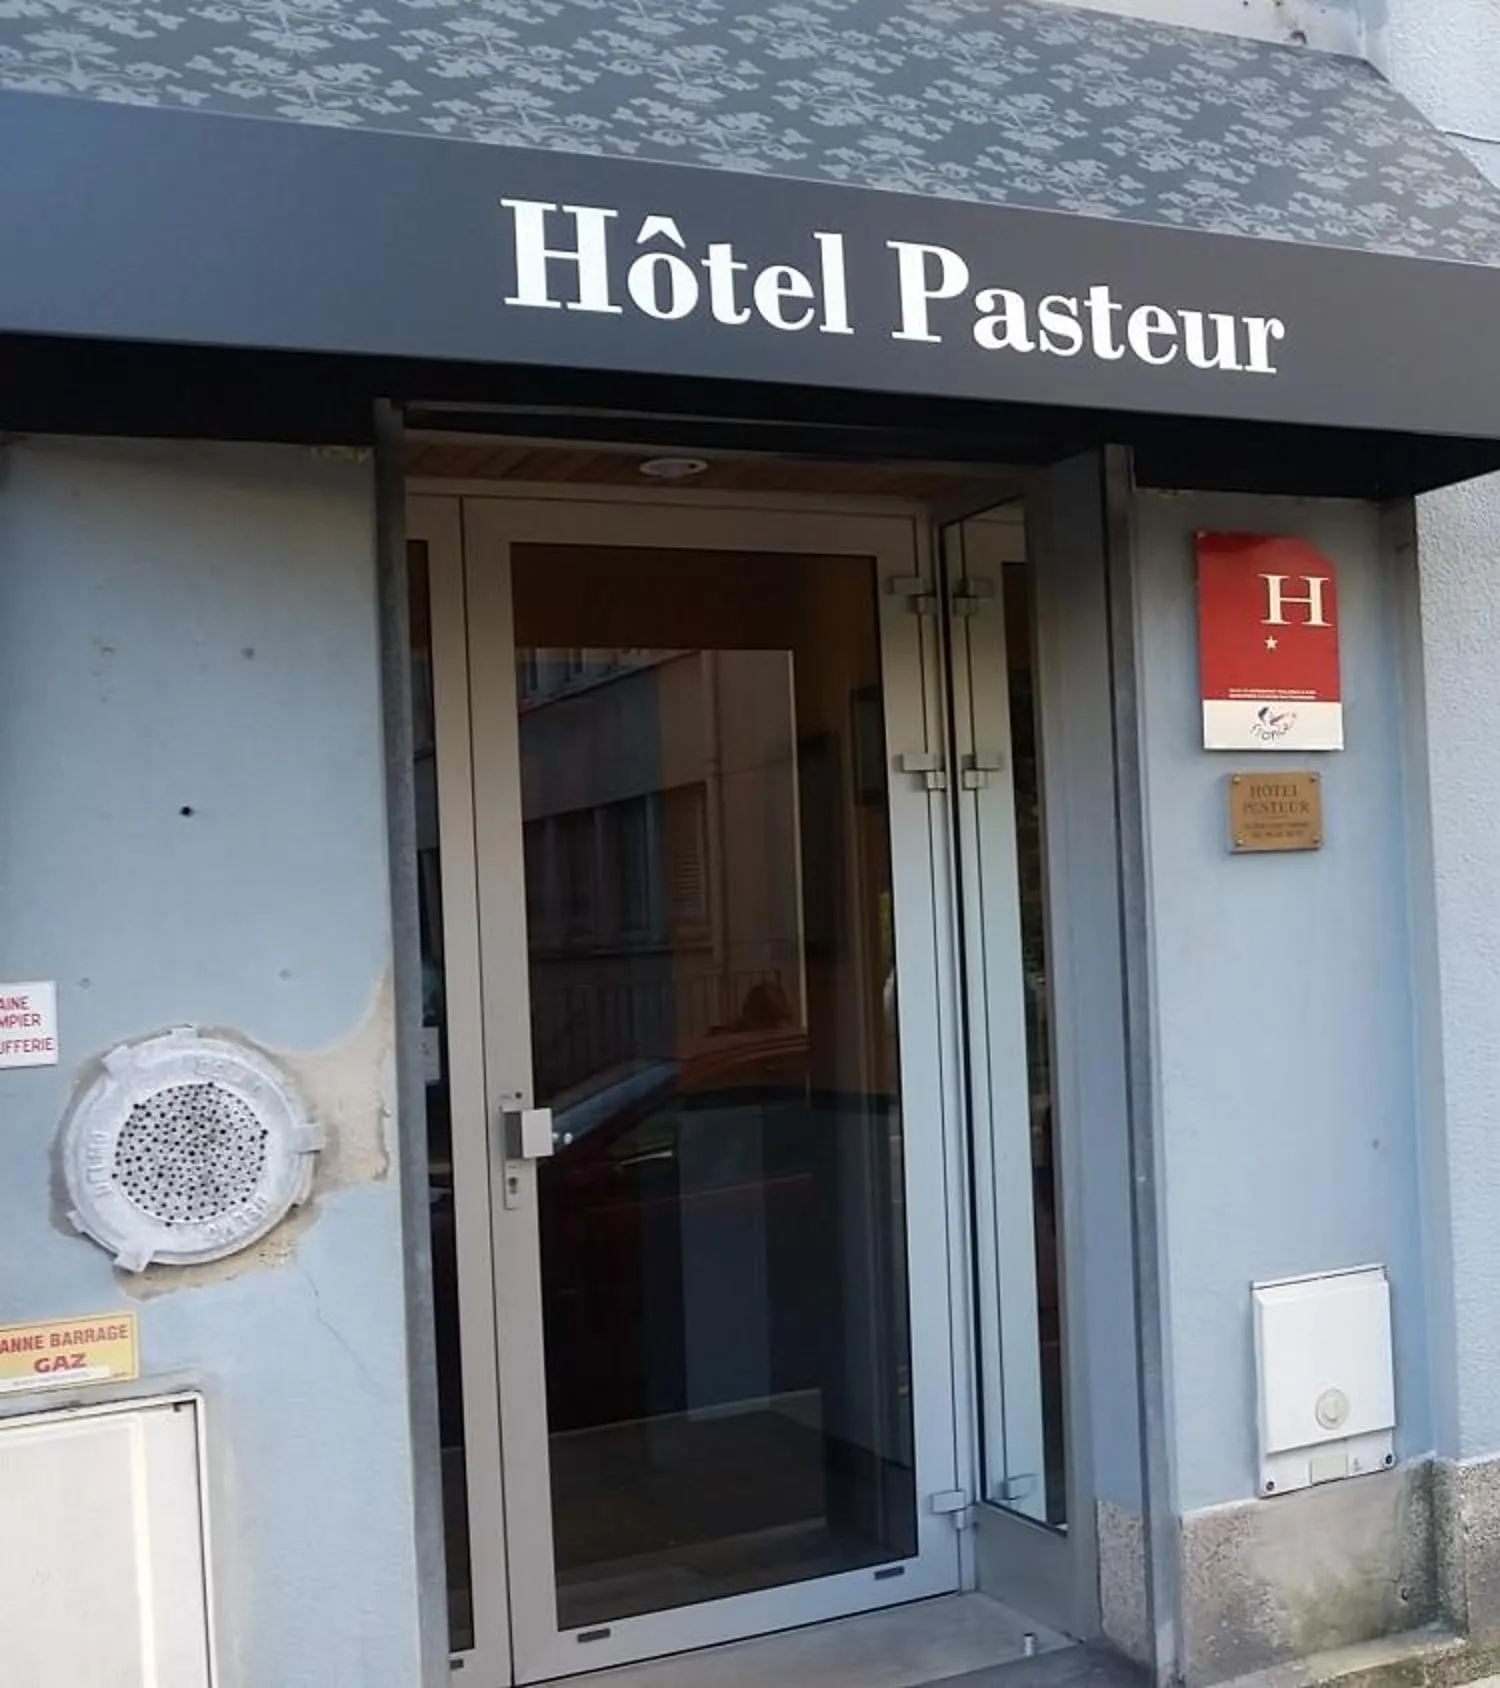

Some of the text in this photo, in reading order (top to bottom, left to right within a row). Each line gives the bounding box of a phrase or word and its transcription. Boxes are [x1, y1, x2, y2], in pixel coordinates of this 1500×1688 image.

[500, 198, 1286, 374] Hôtel Pasteur
[1256, 573, 1334, 627] H
[49, 1324, 129, 1348] BARRAGE
[33, 1352, 87, 1373] GAZ
